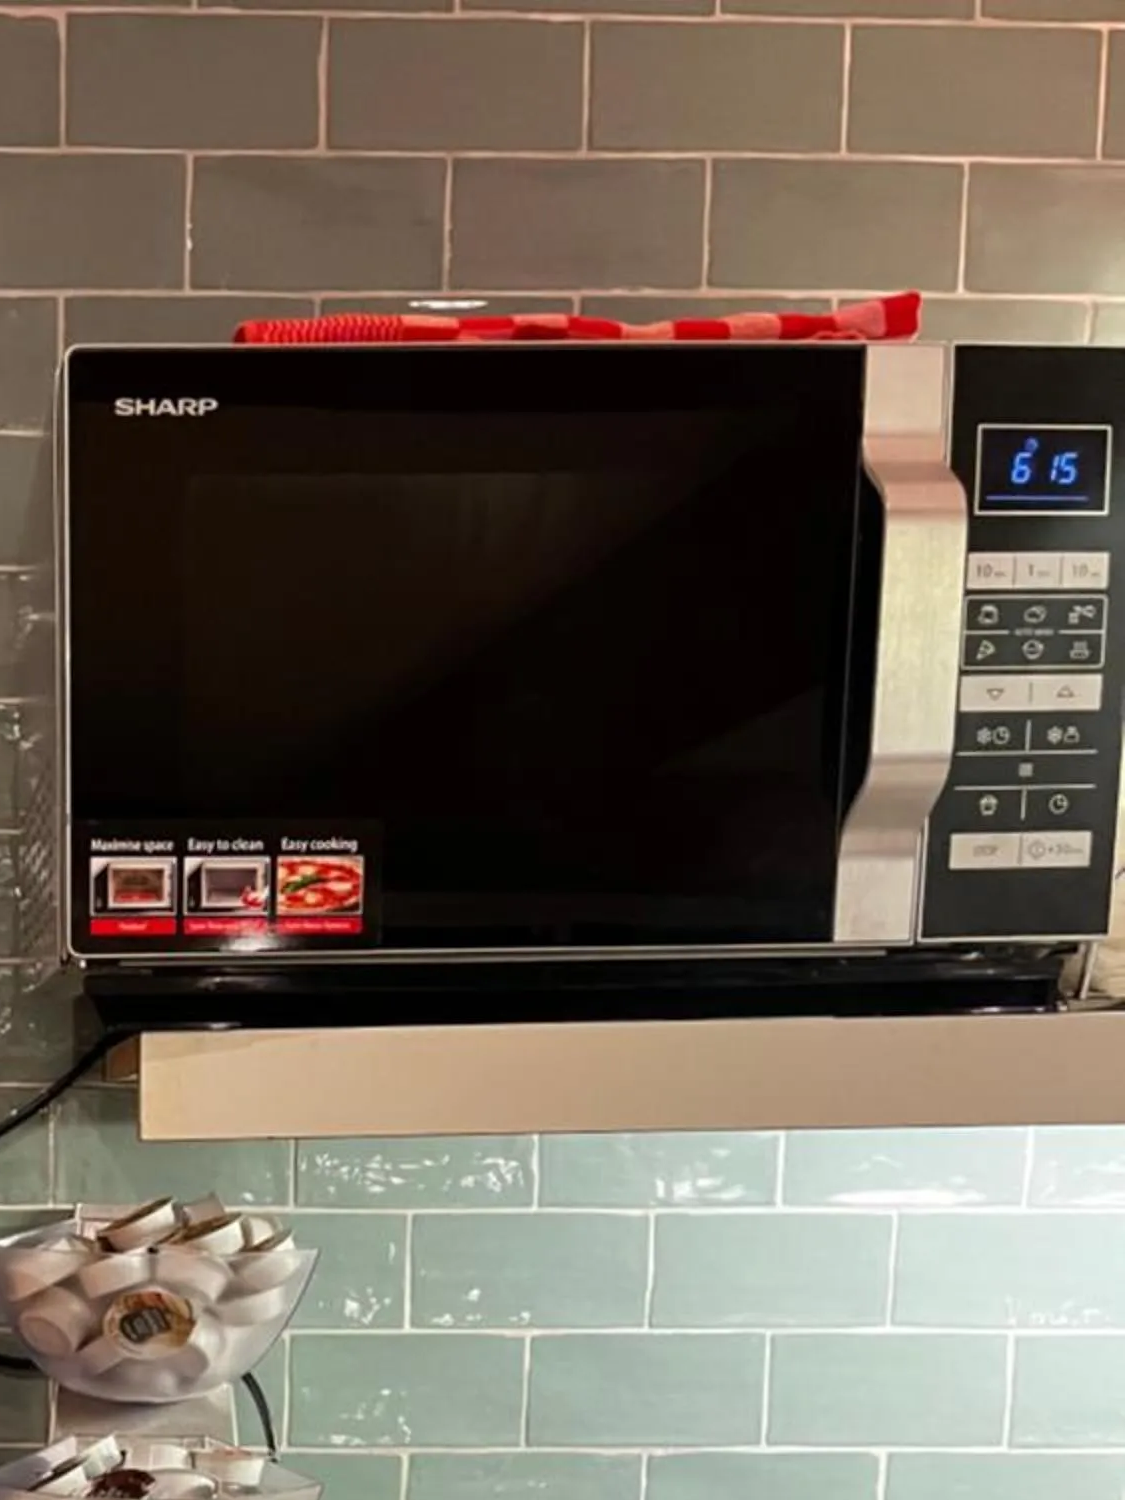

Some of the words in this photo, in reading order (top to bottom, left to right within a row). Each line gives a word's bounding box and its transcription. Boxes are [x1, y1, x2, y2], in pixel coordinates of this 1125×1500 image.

[114, 397, 219, 416] SHARP
[143, 839, 174, 853] space
[187, 837, 214, 854] Easy
[217, 838, 230, 851] to
[232, 838, 264, 852] clean
[281, 836, 308, 852] Easy
[310, 836, 358, 853] cooking
